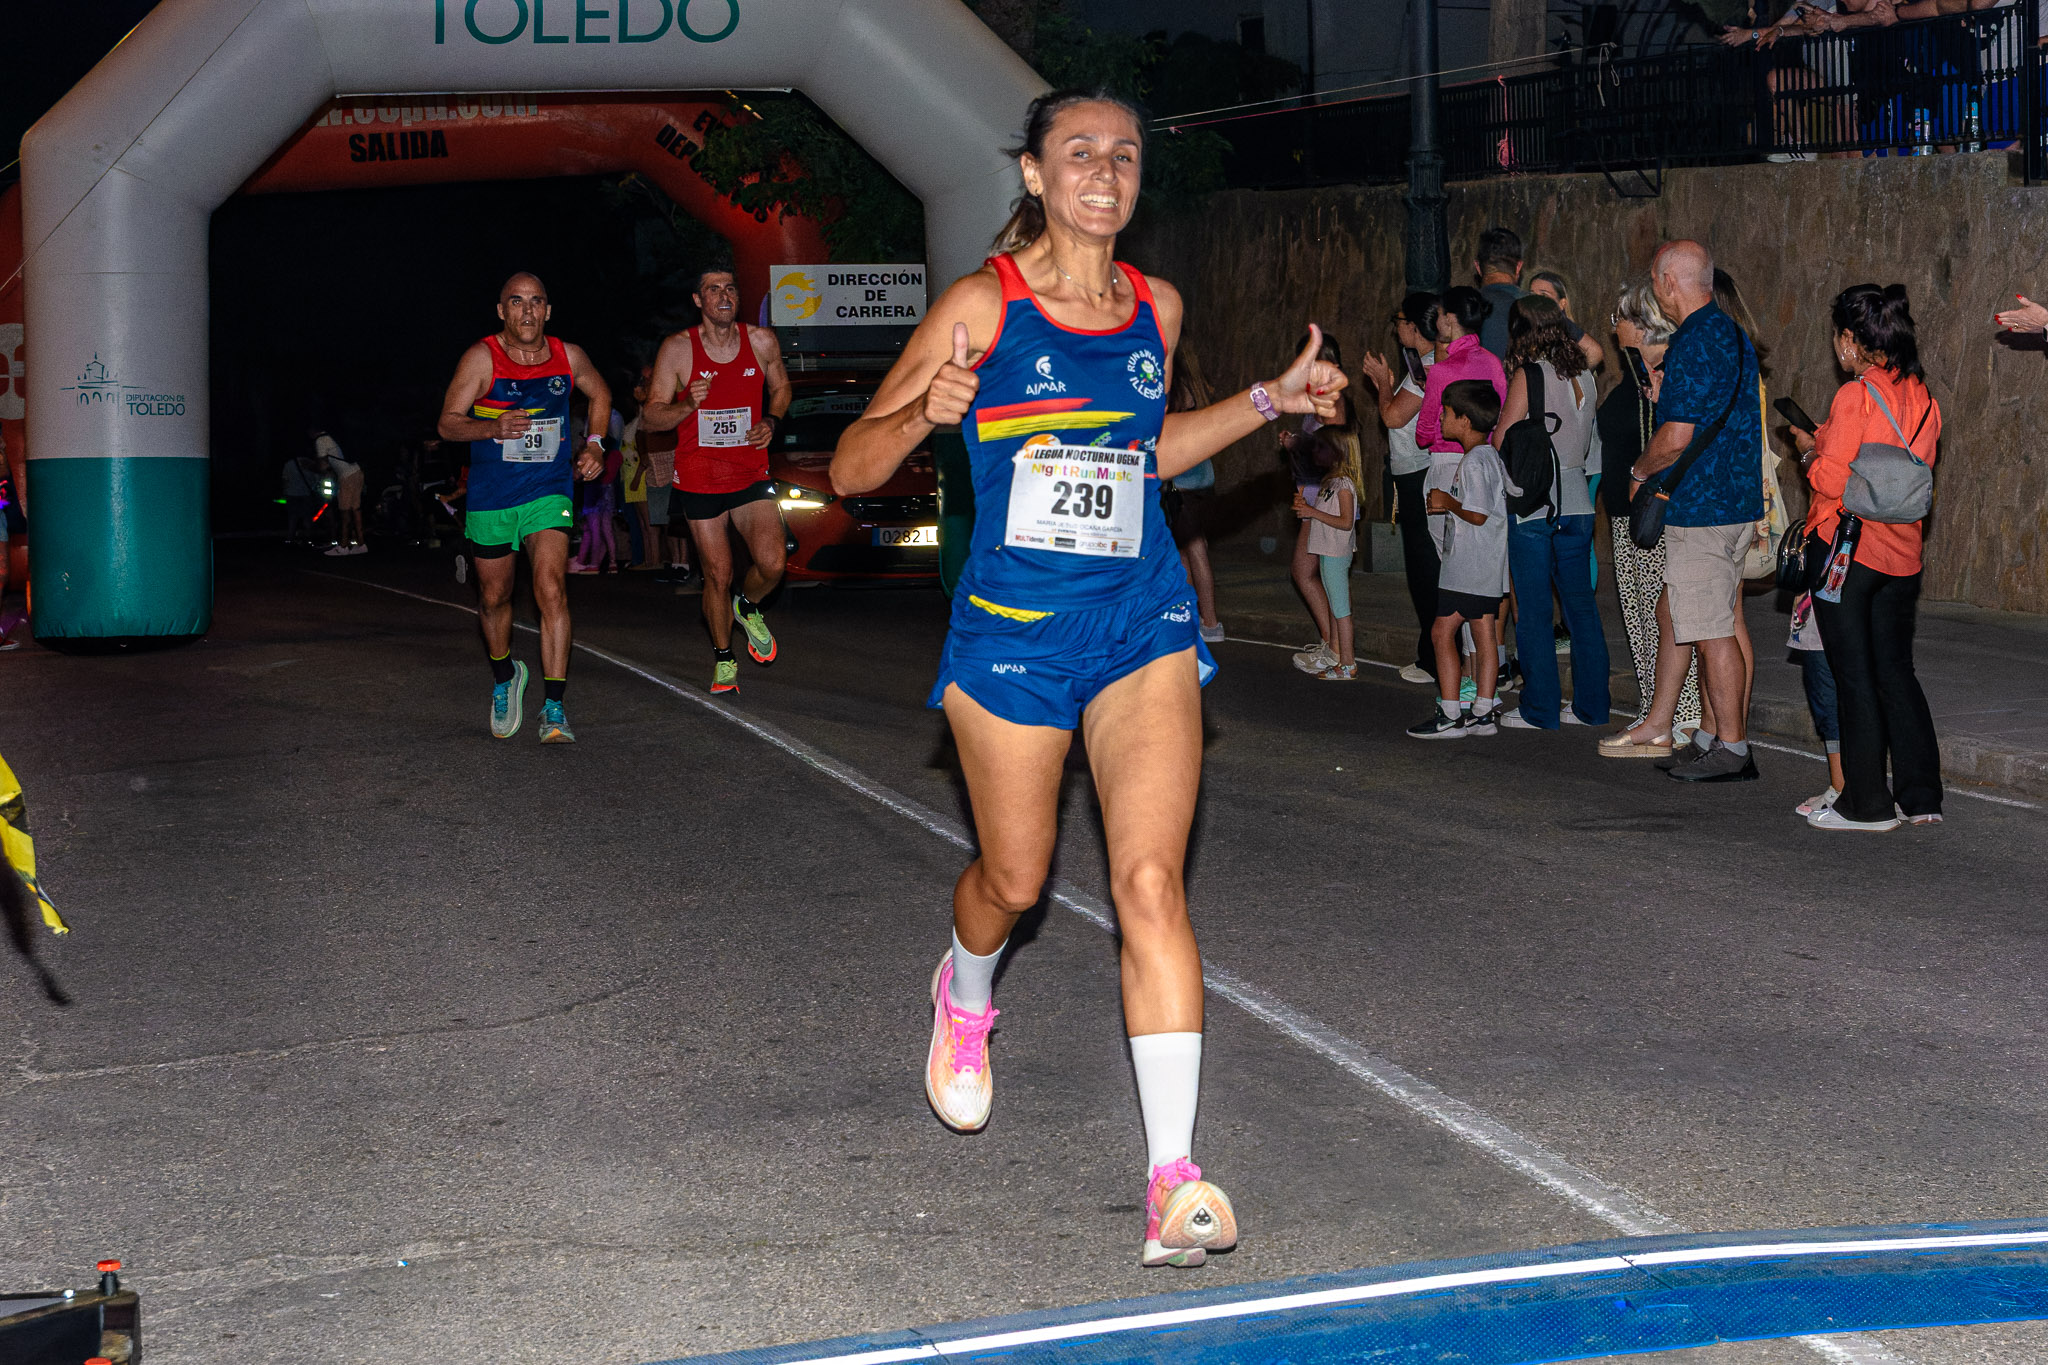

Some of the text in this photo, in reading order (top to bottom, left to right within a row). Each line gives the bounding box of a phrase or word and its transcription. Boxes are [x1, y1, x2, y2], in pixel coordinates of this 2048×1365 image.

[349, 130, 449, 162] SALIDA
[828, 269, 923, 286] DIRECCIÓN
[865, 289, 887, 301] DE
[836, 305, 917, 318] CARRERA
[1026, 380, 1066, 396] AIMAR
[125, 402, 186, 416] TOLEDO
[713, 421, 737, 435] 255
[524, 434, 543, 448] 39
[1034, 448, 1064, 460] LEGUA
[1065, 450, 1115, 464] NOCTURNA
[1116, 454, 1140, 466] UGENA
[1051, 480, 1114, 519] 239
[882, 530, 921, 544] 0282
[992, 663, 1027, 674] AIMAR
